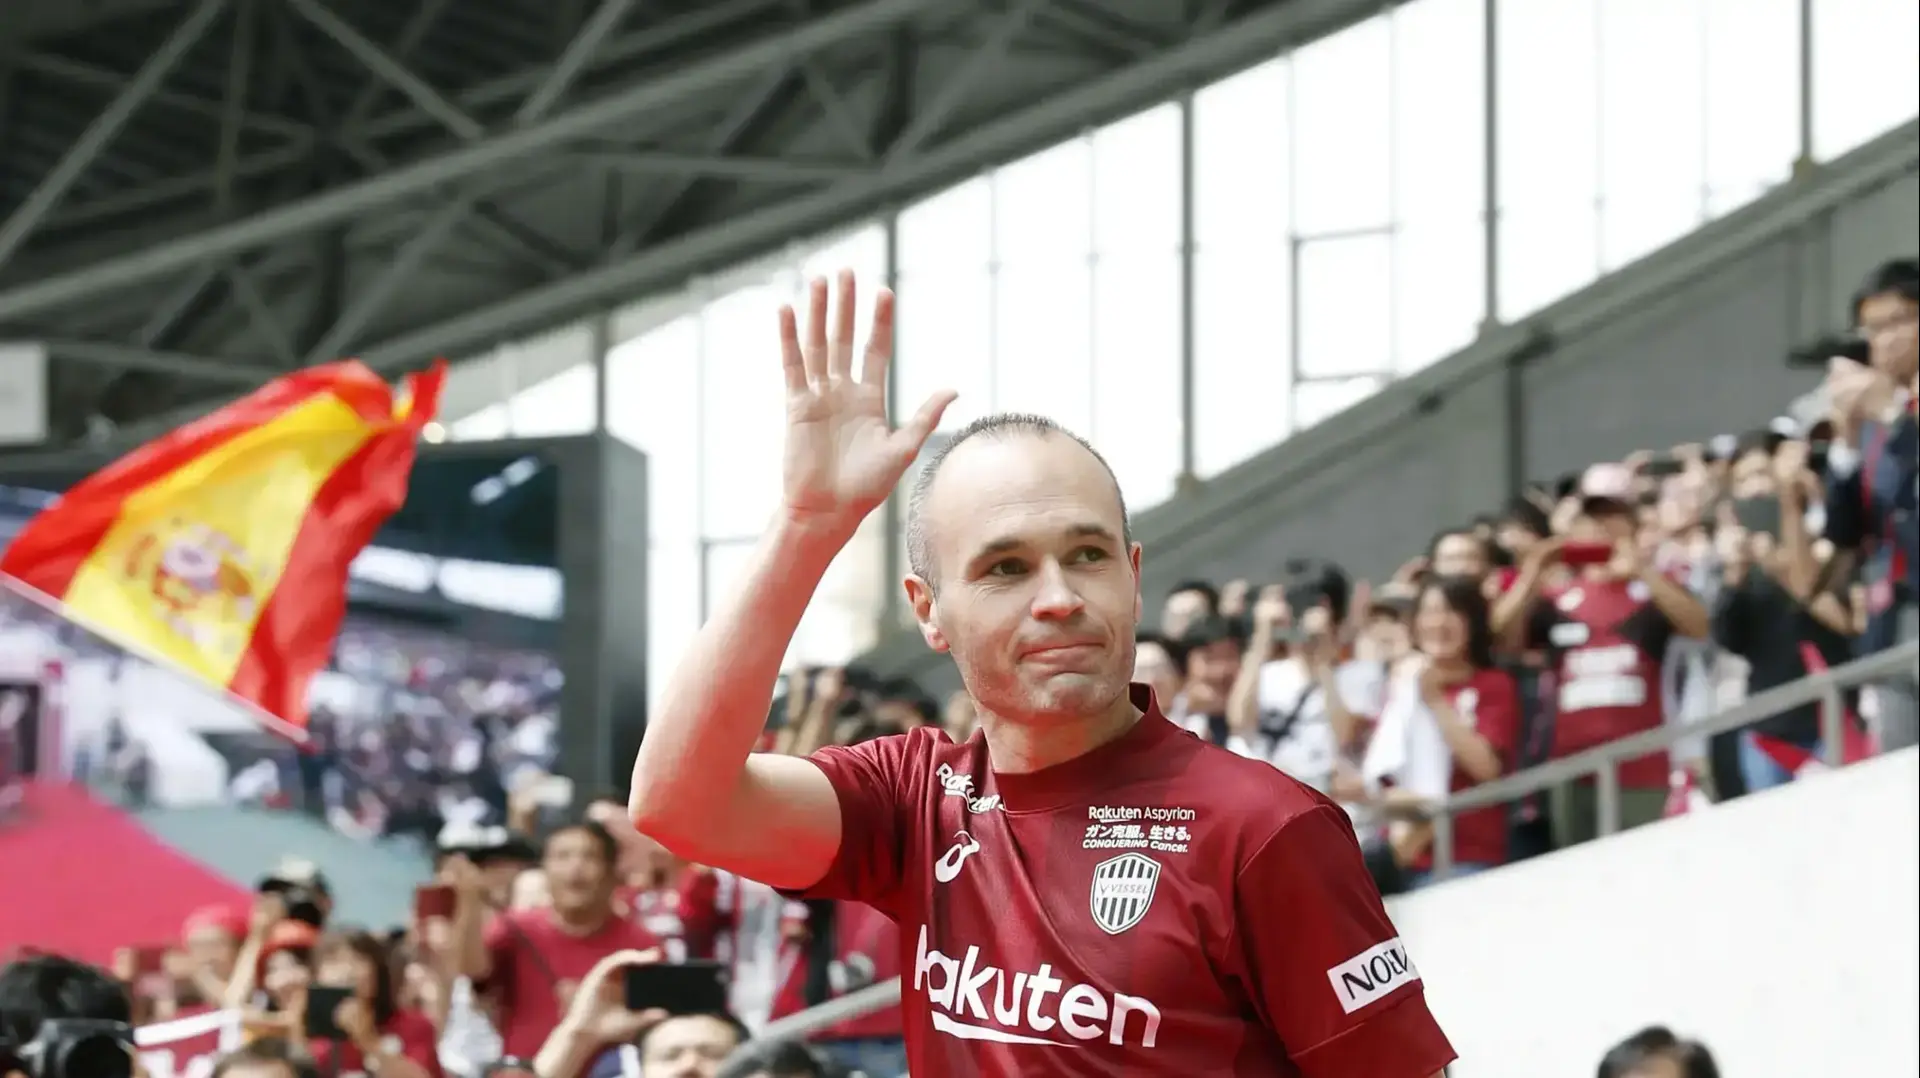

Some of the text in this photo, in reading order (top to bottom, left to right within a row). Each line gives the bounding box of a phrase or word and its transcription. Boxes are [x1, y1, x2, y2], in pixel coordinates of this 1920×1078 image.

[1088, 805, 1196, 822] Rakuten Aspyrian
[1082, 839, 1189, 853] CONQUERING Cancer.
